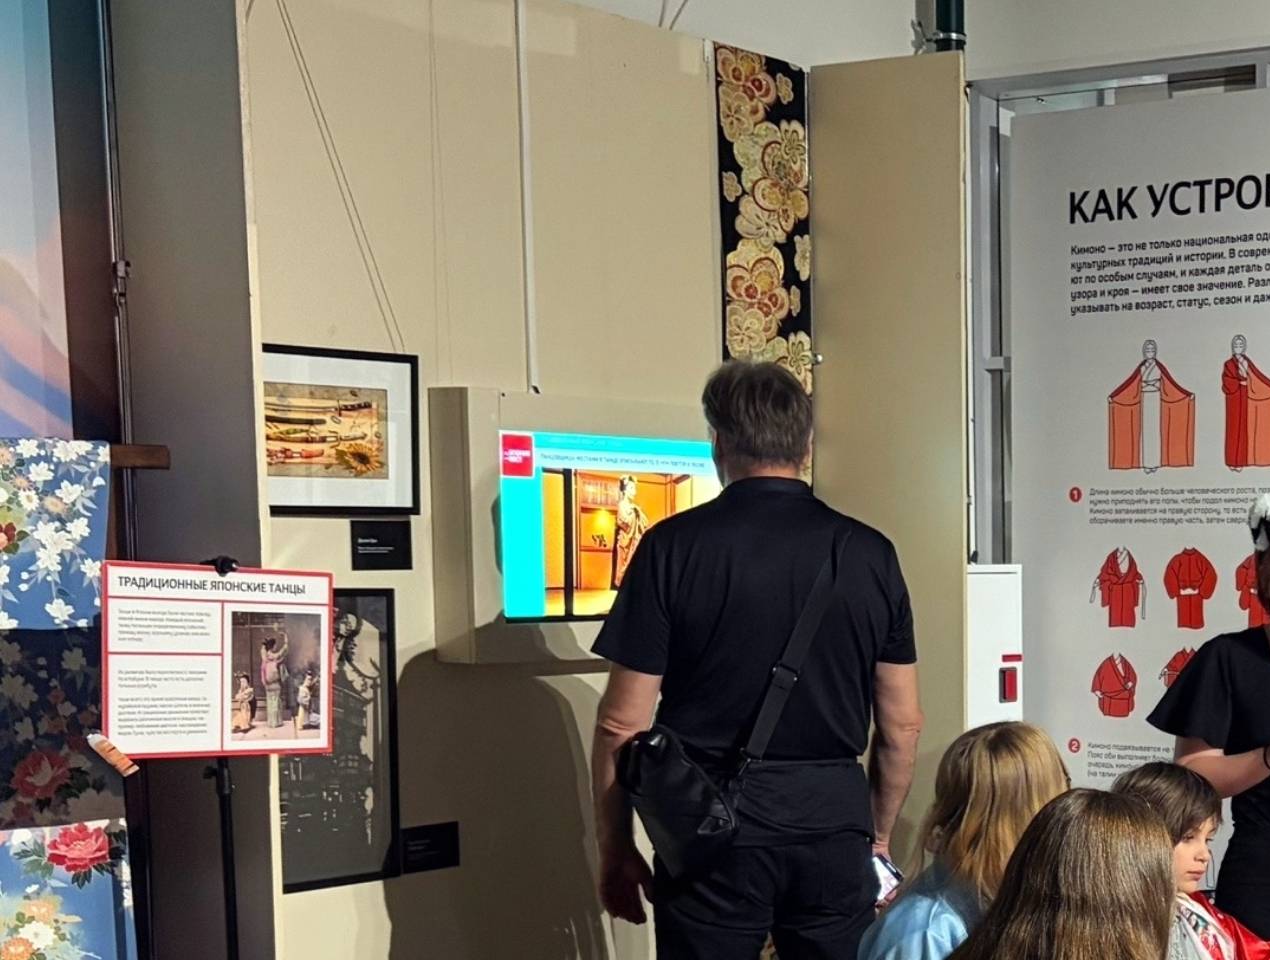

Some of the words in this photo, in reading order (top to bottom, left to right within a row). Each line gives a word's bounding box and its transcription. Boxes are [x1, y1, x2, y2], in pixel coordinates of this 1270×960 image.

[1069, 185, 1138, 224] КАК
[1070, 245, 1106, 256] Кимоно
[1118, 244, 1133, 252] это
[1149, 240, 1182, 249] только
[1184, 233, 1254, 247] национальная
[1070, 259, 1126, 272] культурных
[1128, 253, 1174, 267] традиций
[1184, 251, 1226, 264] истории.
[1229, 248, 1236, 258] В
[1070, 275, 1083, 284] ют
[1085, 275, 1096, 284] по
[1098, 270, 1134, 283] особым
[1136, 269, 1179, 282] случаям,
[1181, 269, 1187, 277] и
[1189, 266, 1226, 278] каждая
[1228, 263, 1263, 276] деталь
[1070, 290, 1098, 302] узора
[1100, 289, 1106, 298] и
[1107, 288, 1130, 299] кроя
[1141, 286, 1169, 295] имеет
[1172, 285, 1195, 294] свое
[1197, 281, 1246, 293] значение.
[1070, 304, 1120, 316] указывать
[1122, 303, 1133, 311] на
[1135, 300, 1175, 313] возраст,
[1176, 298, 1212, 310] статус,
[1214, 295, 1242, 306] сезон
[1245, 295, 1251, 303] и
[118, 576, 208, 591] ТРАДИЦИОННЫЕ
[210, 581, 266, 592] ЯПОНСКИЕ
[269, 583, 306, 595] ТАНЦЫ
